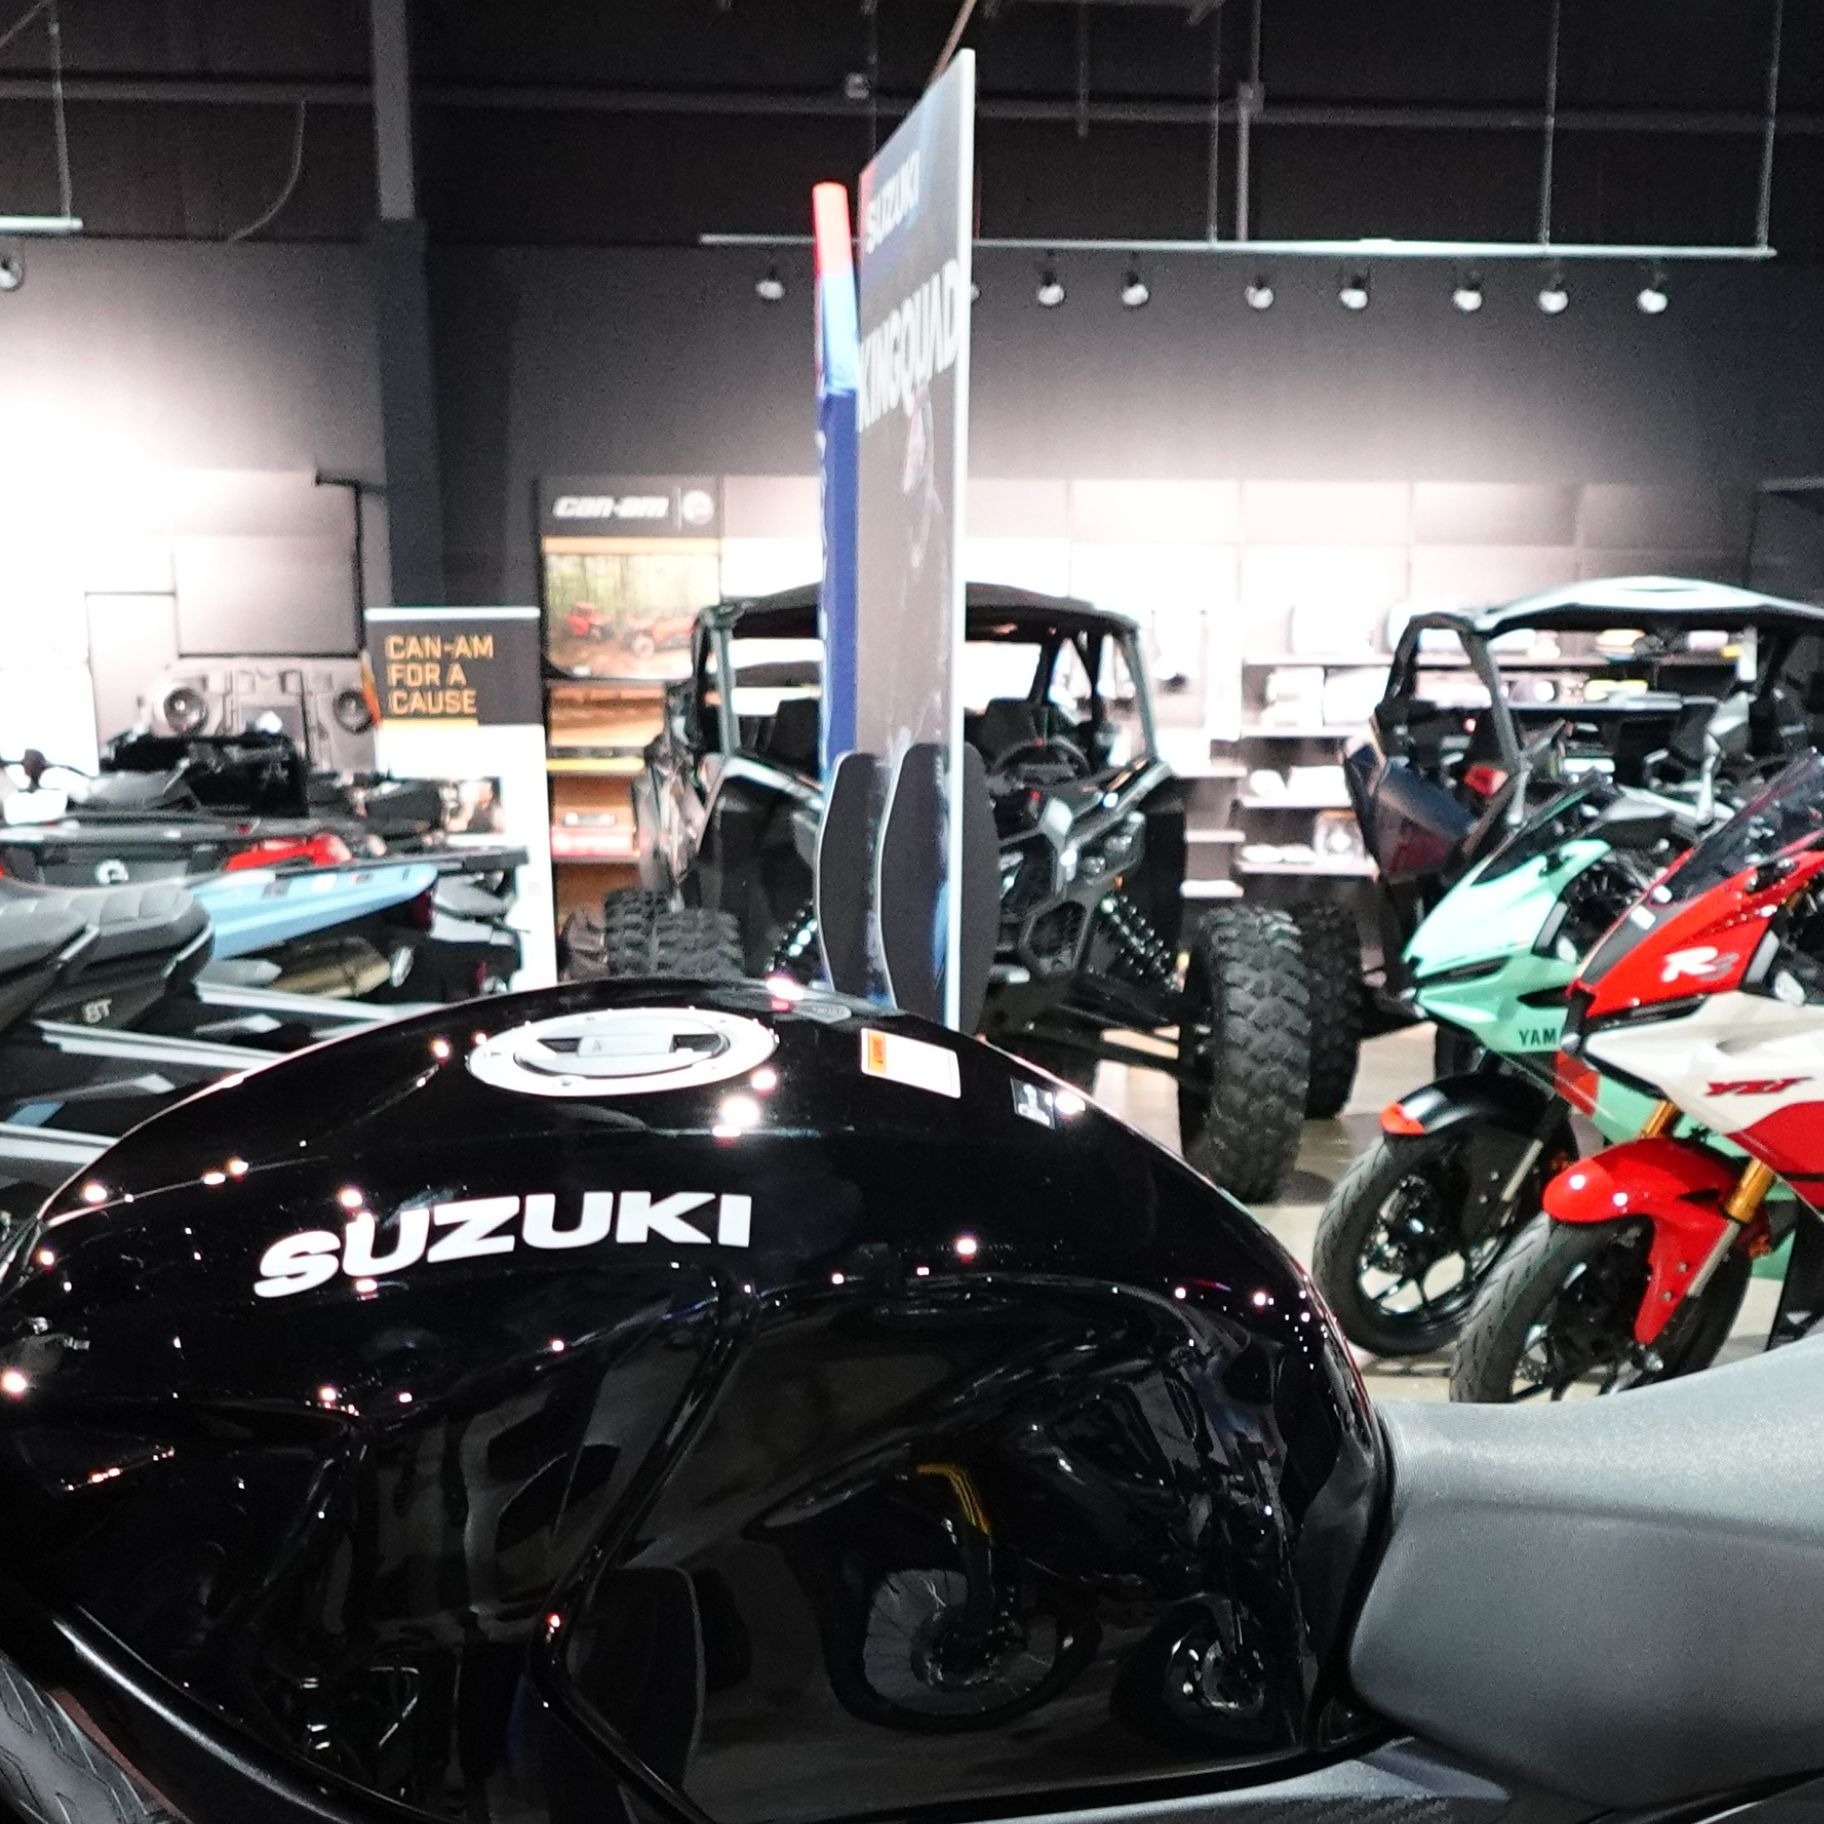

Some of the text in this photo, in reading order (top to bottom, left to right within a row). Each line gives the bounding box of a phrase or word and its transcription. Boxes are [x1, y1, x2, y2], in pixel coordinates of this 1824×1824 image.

[385, 633, 495, 660] CAN-AM
[387, 661, 468, 687] FOR A
[388, 688, 478, 714] CAUSE
[1518, 1028, 1557, 1046] YAM
[253, 1190, 753, 1299] SUZUKI
